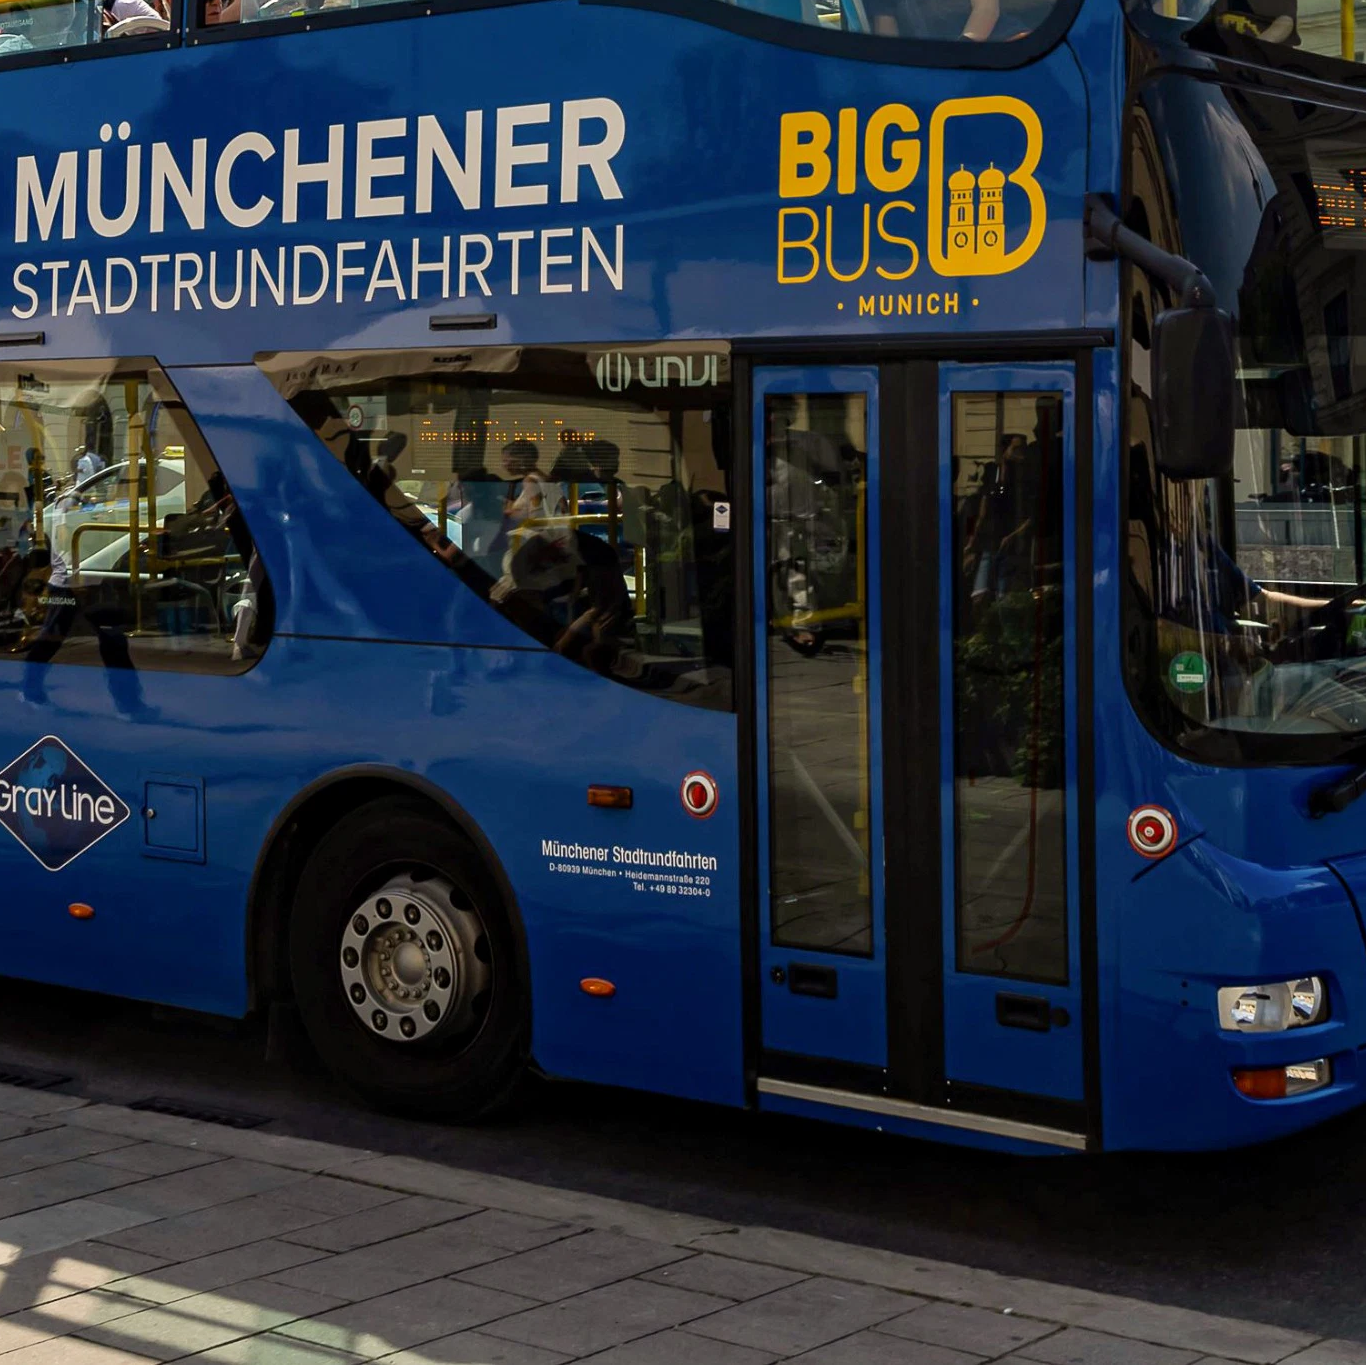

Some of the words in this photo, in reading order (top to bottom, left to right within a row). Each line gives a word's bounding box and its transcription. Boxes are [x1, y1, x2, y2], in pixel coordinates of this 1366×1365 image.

[14, 97, 626, 243] MÜNCHENER
[779, 103, 921, 198] BIG
[777, 200, 920, 284] BUS
[11, 225, 624, 319] STADTRUNDFAHRTEN
[858, 292, 959, 316] MUNICH
[542, 839, 608, 861] Münchener
[613, 846, 717, 871] Stadtrundfahrten
[549, 862, 580, 874] D-80939
[582, 866, 617, 878] München
[625, 870, 694, 885] Heidemannstraße
[695, 876, 710, 886] 220
[633, 881, 647, 892] Tel.
[649, 883, 665, 894] +49
[667, 884, 677, 895] 89
[678, 885, 711, 897] 32304-0
